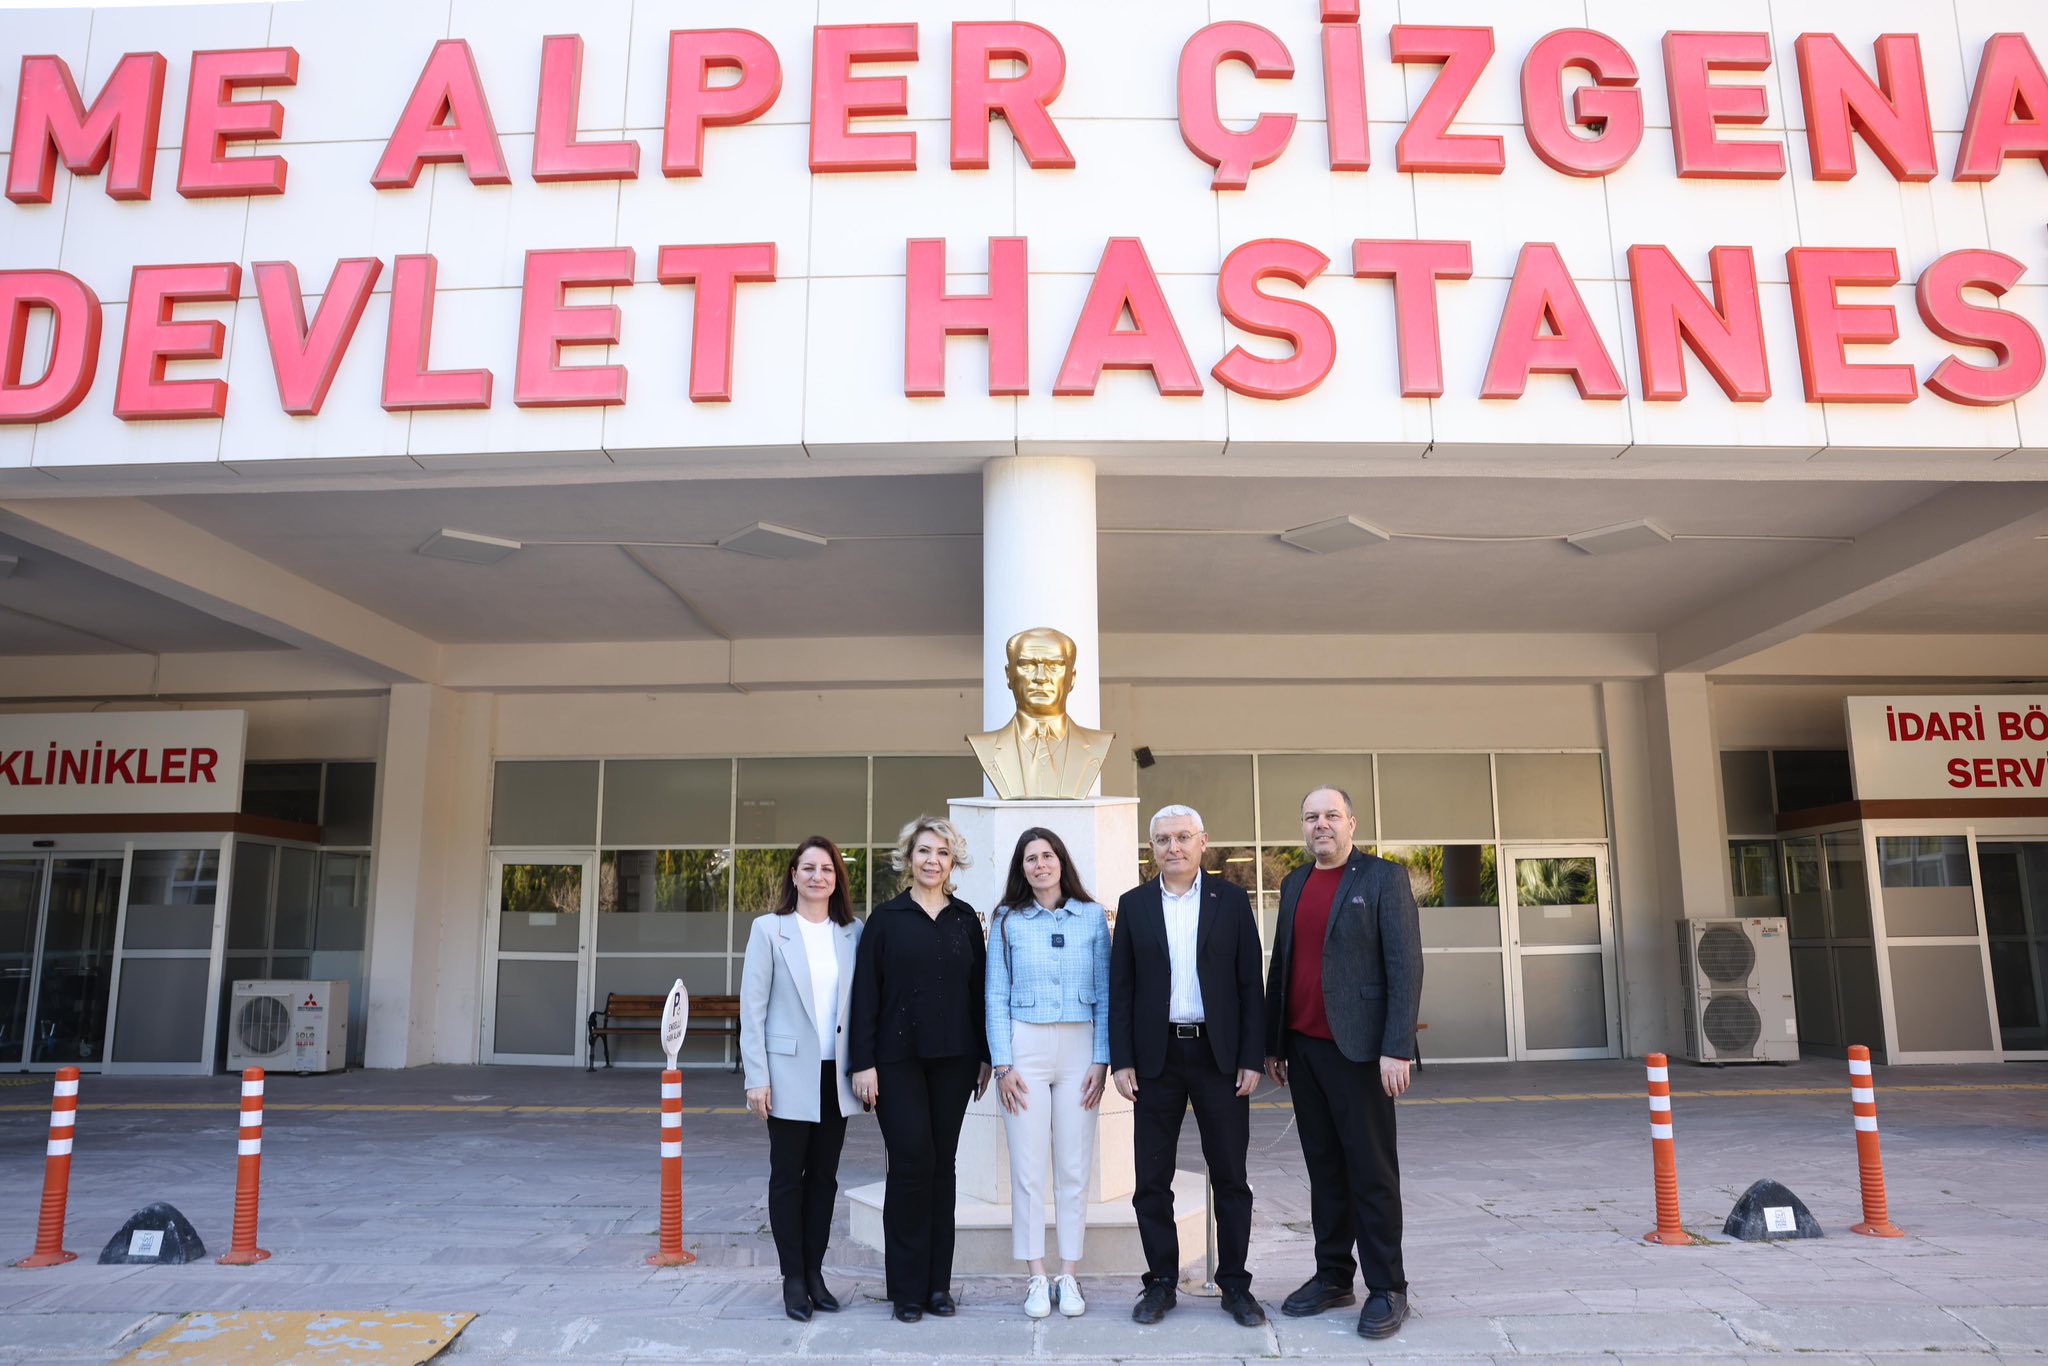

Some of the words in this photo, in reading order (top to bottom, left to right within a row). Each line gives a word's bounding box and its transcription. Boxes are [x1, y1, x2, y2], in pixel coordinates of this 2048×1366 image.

[4, 46, 299, 204] ME
[370, 21, 1076, 190] ALPER
[1176, 0, 2048, 191] ÇİZGENA
[0, 242, 778, 425] DEVLET
[904, 236, 2048, 407] HASTANES
[1886, 705, 1985, 742] İDARİ
[0, 740, 218, 785] KLİNİKLER
[1947, 752, 2048, 788] SERV
[672, 991, 681, 1017] P
